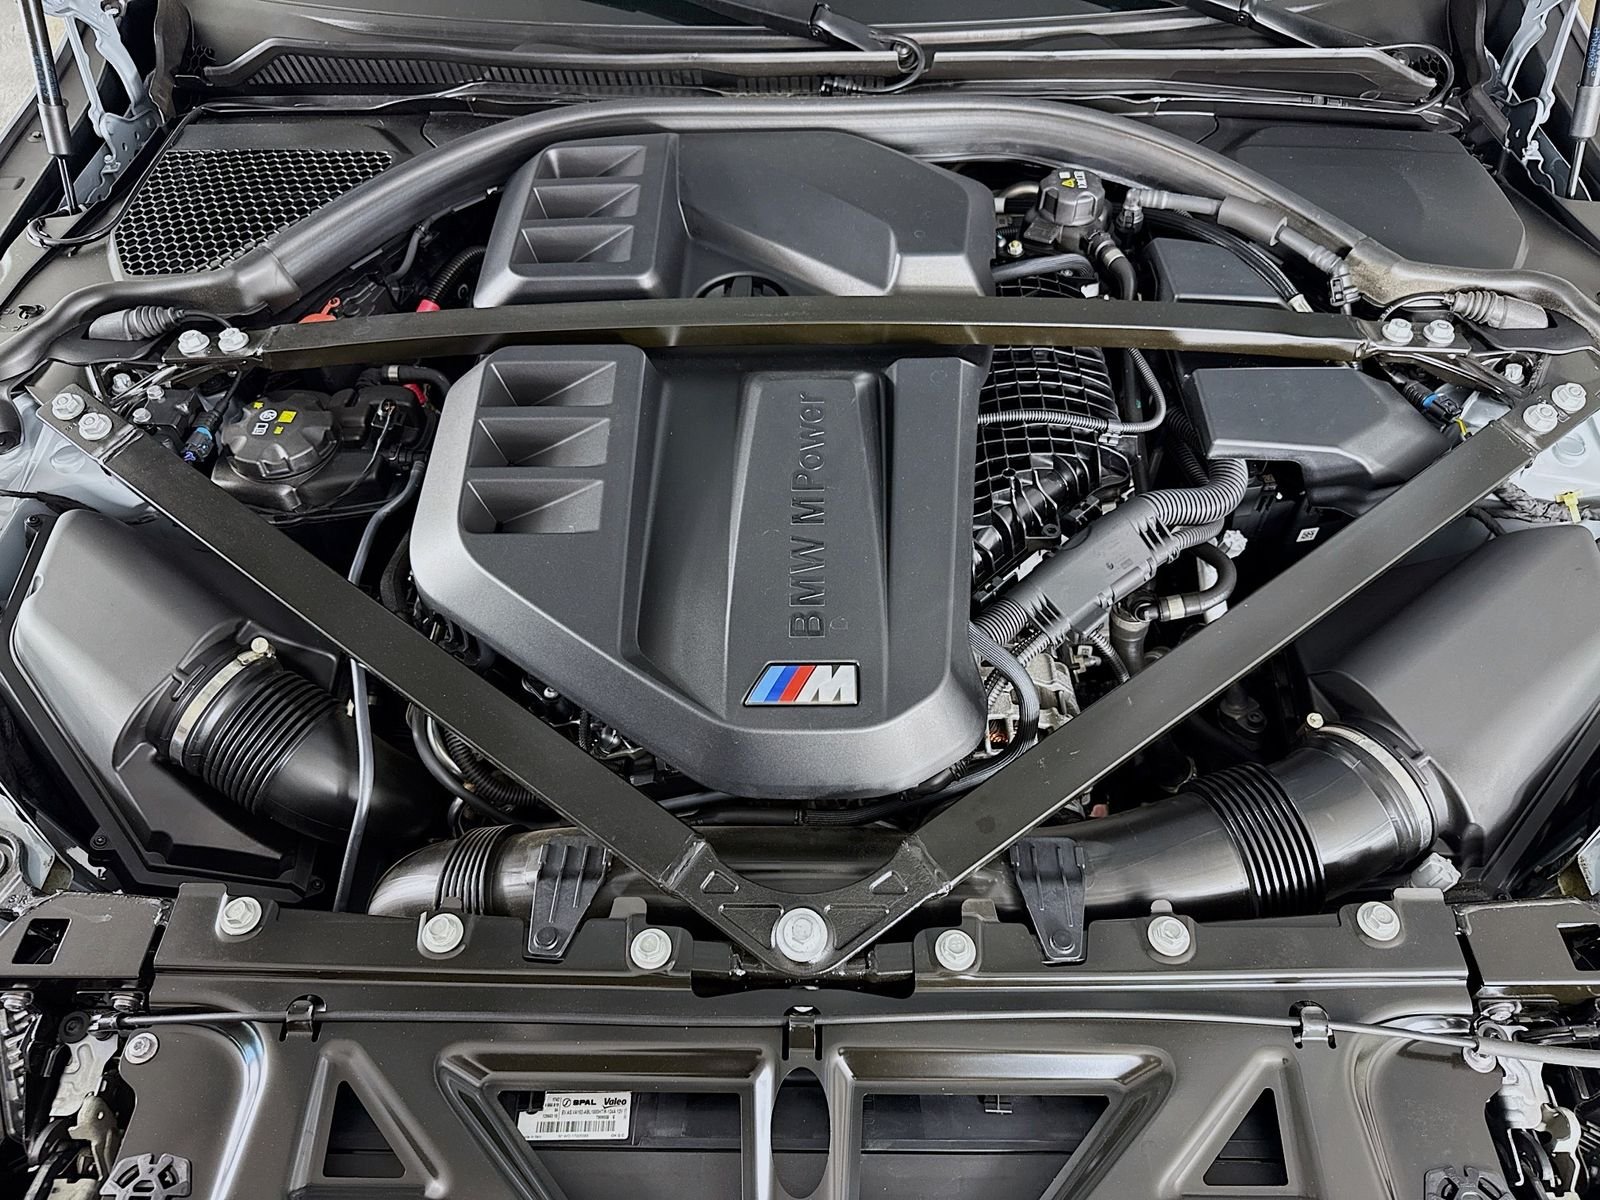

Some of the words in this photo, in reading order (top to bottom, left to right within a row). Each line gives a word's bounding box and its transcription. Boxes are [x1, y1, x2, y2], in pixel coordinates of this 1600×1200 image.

[788, 536, 825, 638] BMW
[794, 664, 858, 703] M
[603, 1097, 627, 1106] Valeo
